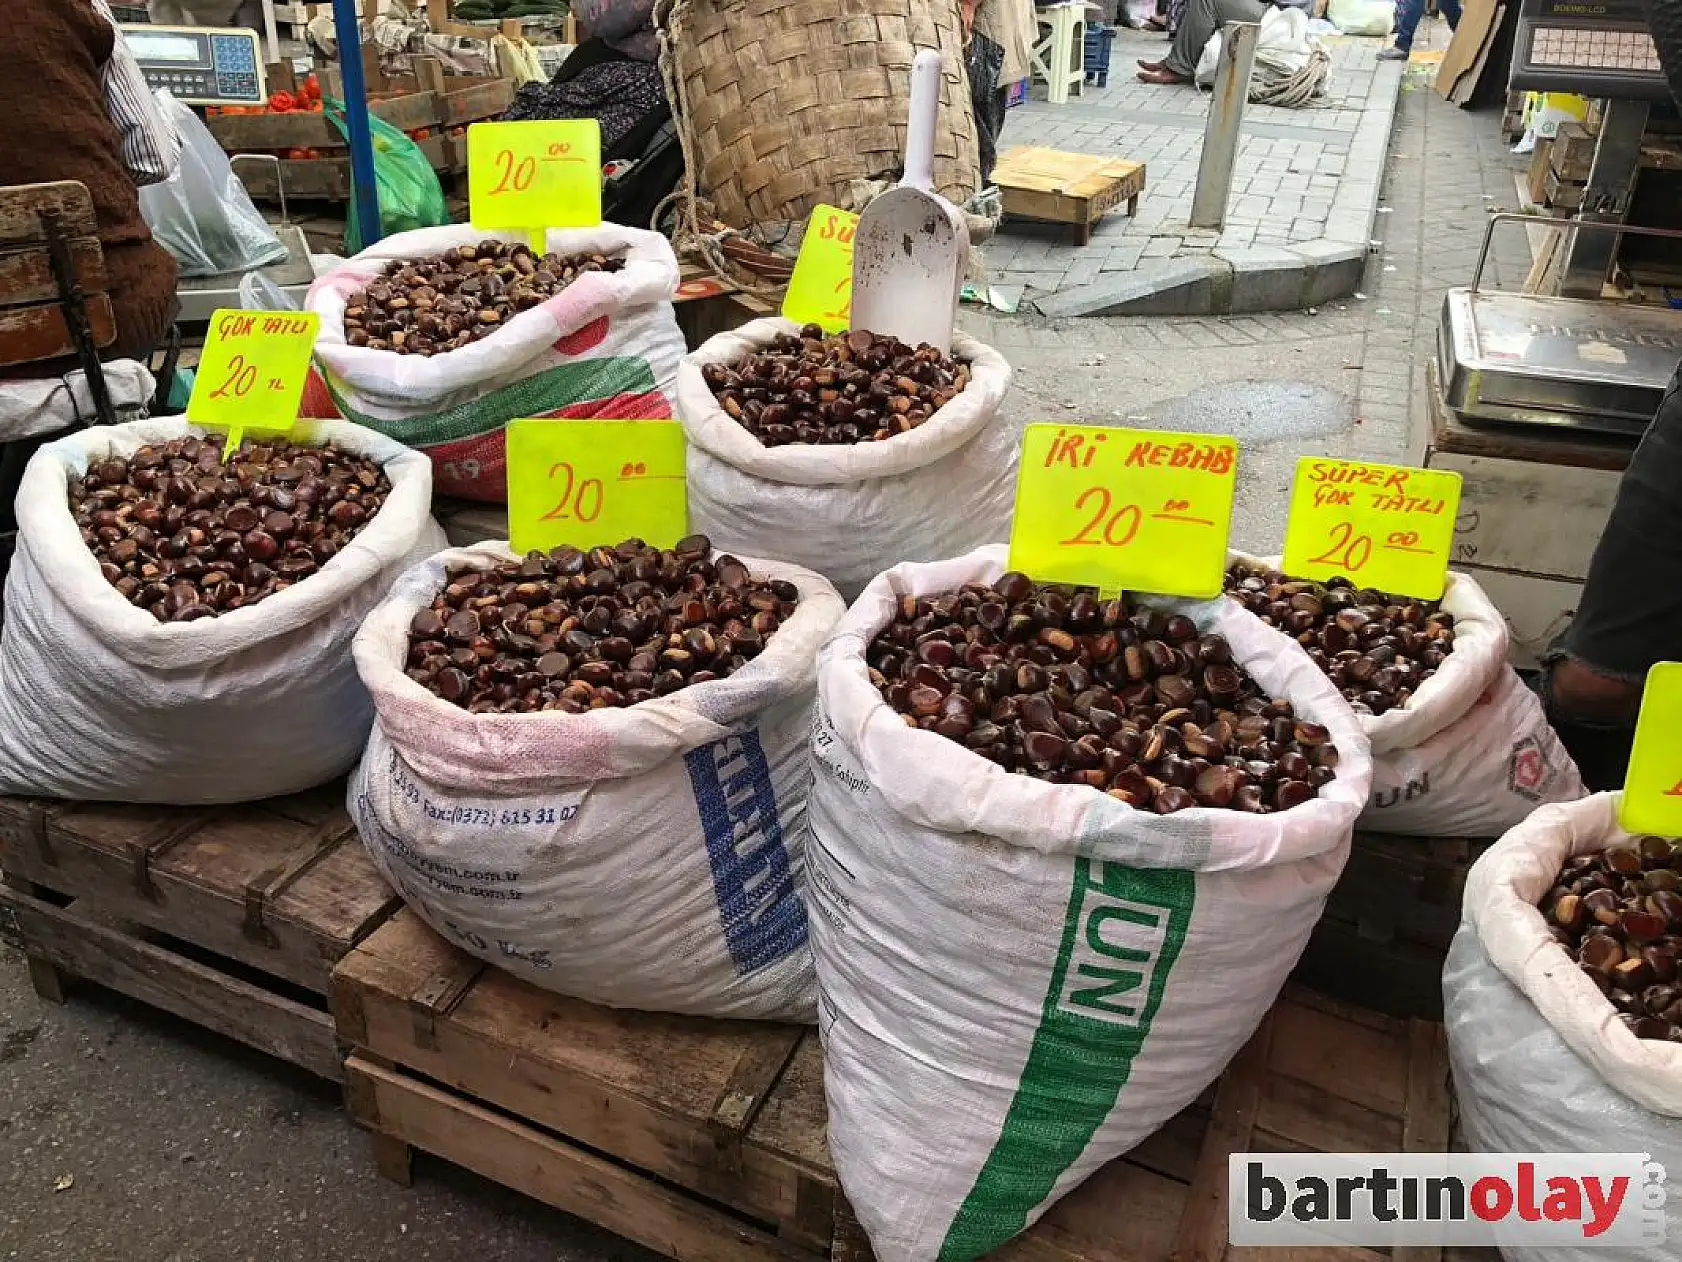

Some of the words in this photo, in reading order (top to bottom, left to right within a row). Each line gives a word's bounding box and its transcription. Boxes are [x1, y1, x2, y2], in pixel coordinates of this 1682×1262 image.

[487, 149, 536, 196] 20
[208, 354, 257, 398] 20
[1124, 441, 1234, 474] KEBAB
[1308, 462, 1409, 494] SÜPER
[538, 462, 604, 523] 20
[1370, 493, 1445, 515] TATLI
[1058, 486, 1142, 547] 20
[1307, 522, 1372, 571] 20
[1388, 531, 1419, 546] 00
[535, 808, 555, 824] 31
[1069, 905, 1160, 1017] UN
